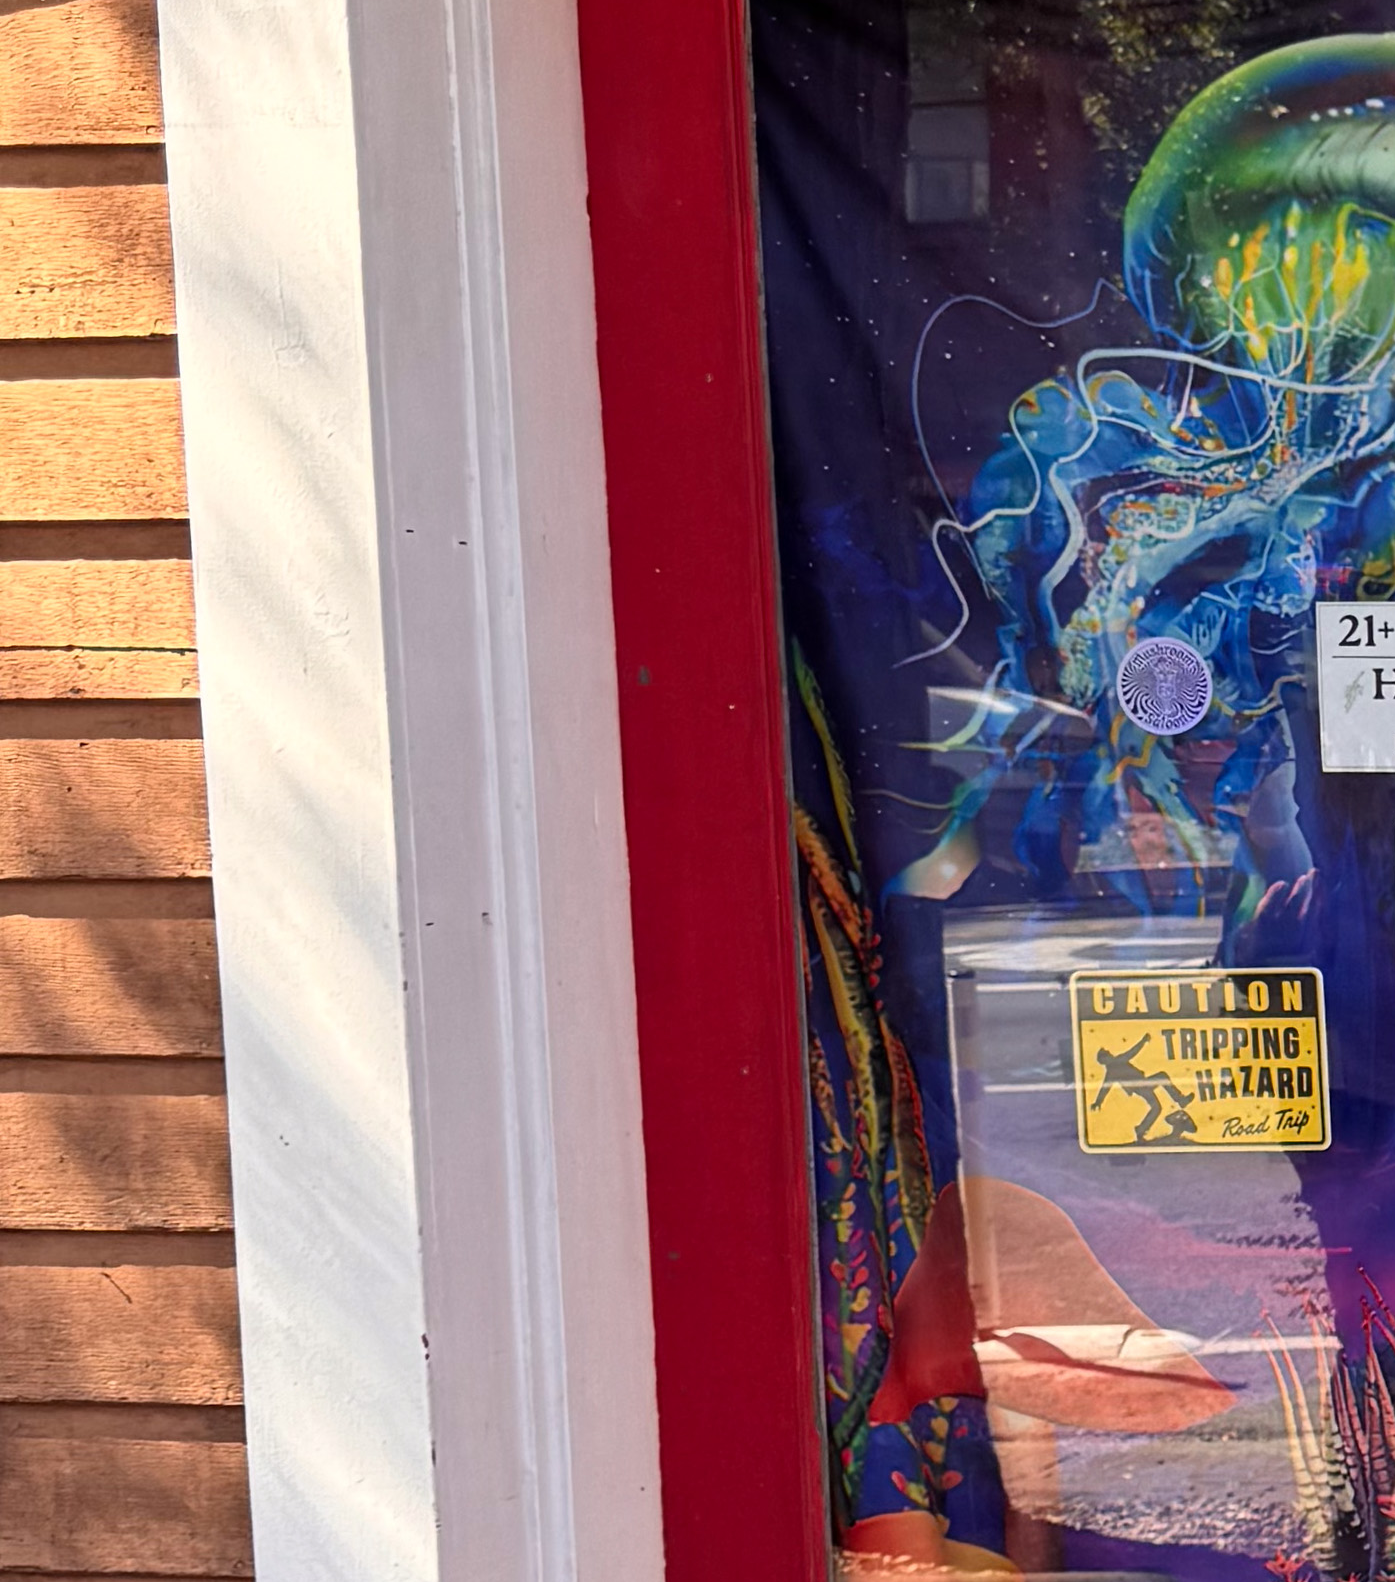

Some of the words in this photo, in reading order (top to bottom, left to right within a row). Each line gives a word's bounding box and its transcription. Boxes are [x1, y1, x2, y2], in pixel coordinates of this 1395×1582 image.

[1337, 615, 1395, 648] 21+
[1133, 644, 1198, 676] Mushroom
[1144, 712, 1189, 730] Saloon
[1092, 980, 1304, 1015] CAUTION
[1161, 1027, 1301, 1062] TRIPPING
[1195, 1066, 1314, 1103] HAZARD
[1221, 1116, 1270, 1139] Road
[1274, 1108, 1311, 1135] Trip
